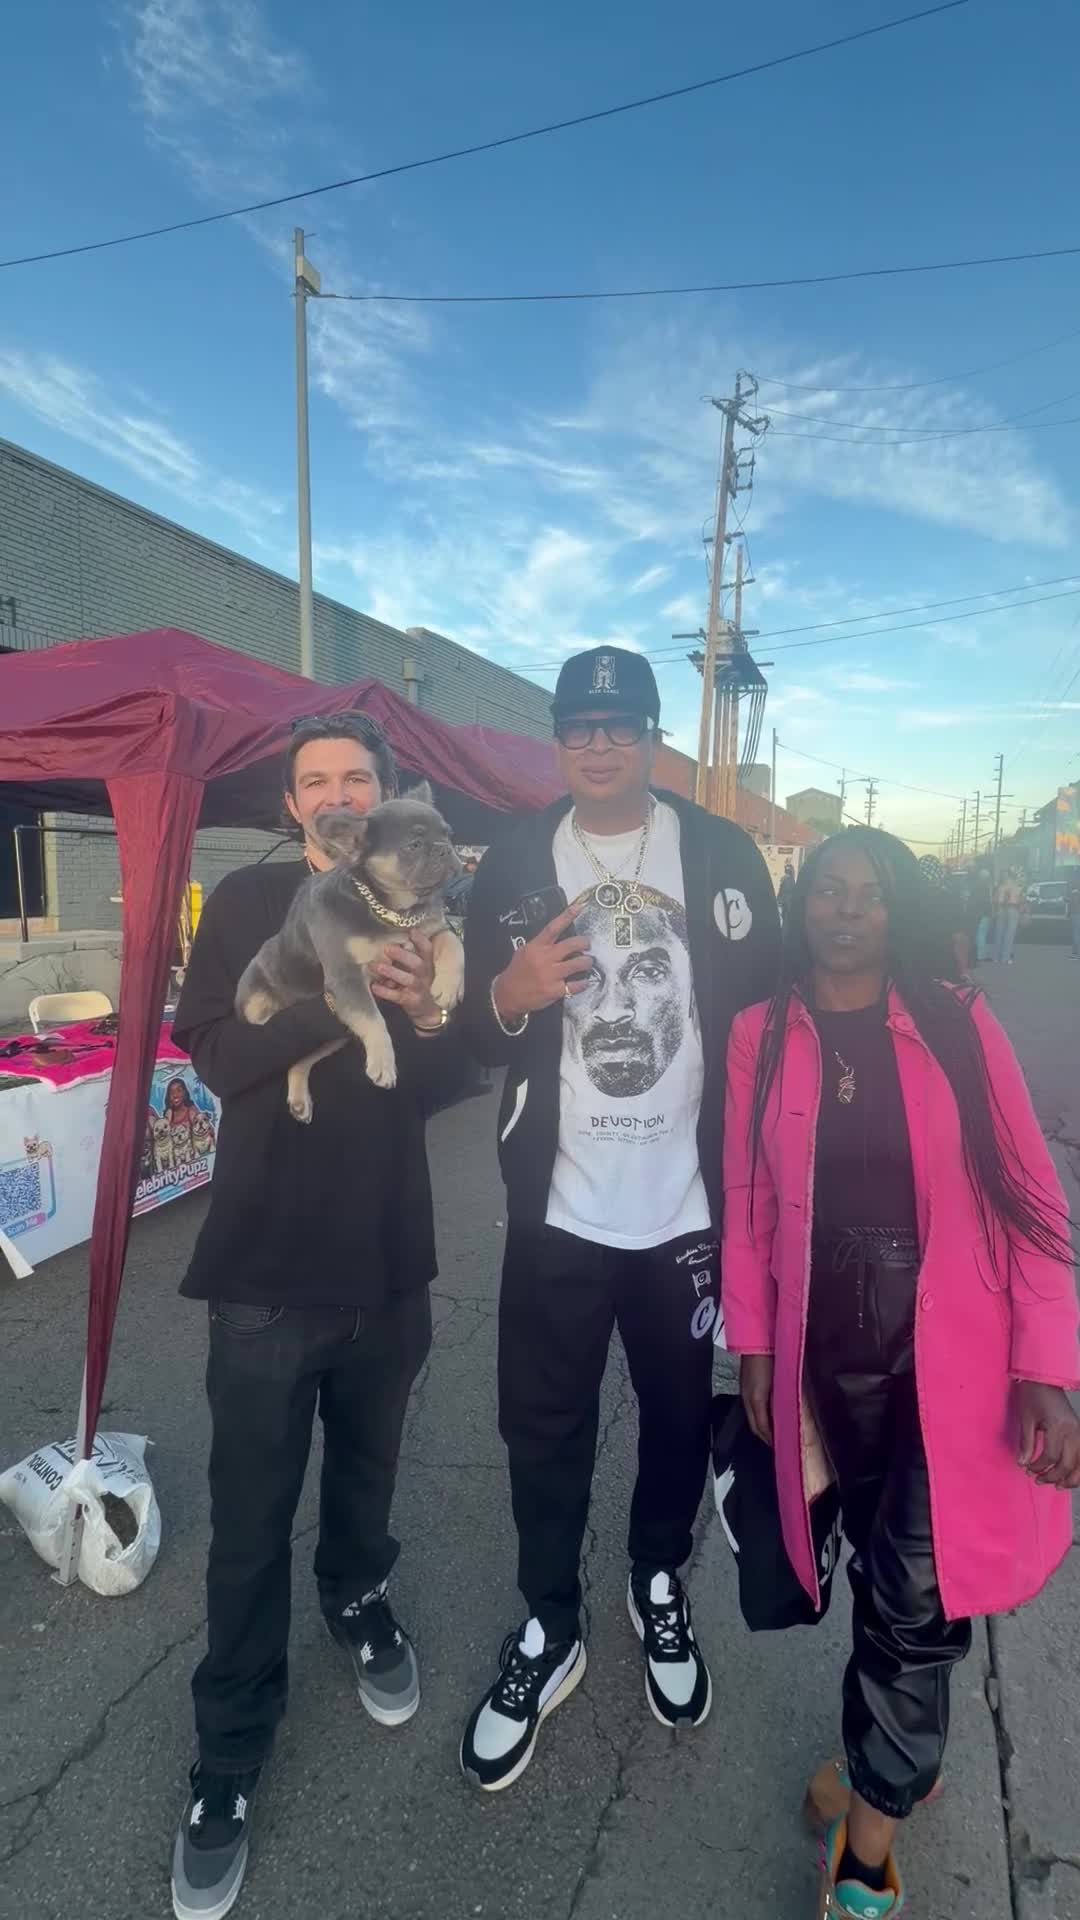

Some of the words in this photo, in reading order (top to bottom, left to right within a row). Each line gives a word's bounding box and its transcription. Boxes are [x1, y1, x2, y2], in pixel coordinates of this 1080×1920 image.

[590, 1114, 665, 1131] DEVOTION
[134, 1158, 208, 1200] elebrityPupz
[26, 1453, 64, 1491] CONTROL
